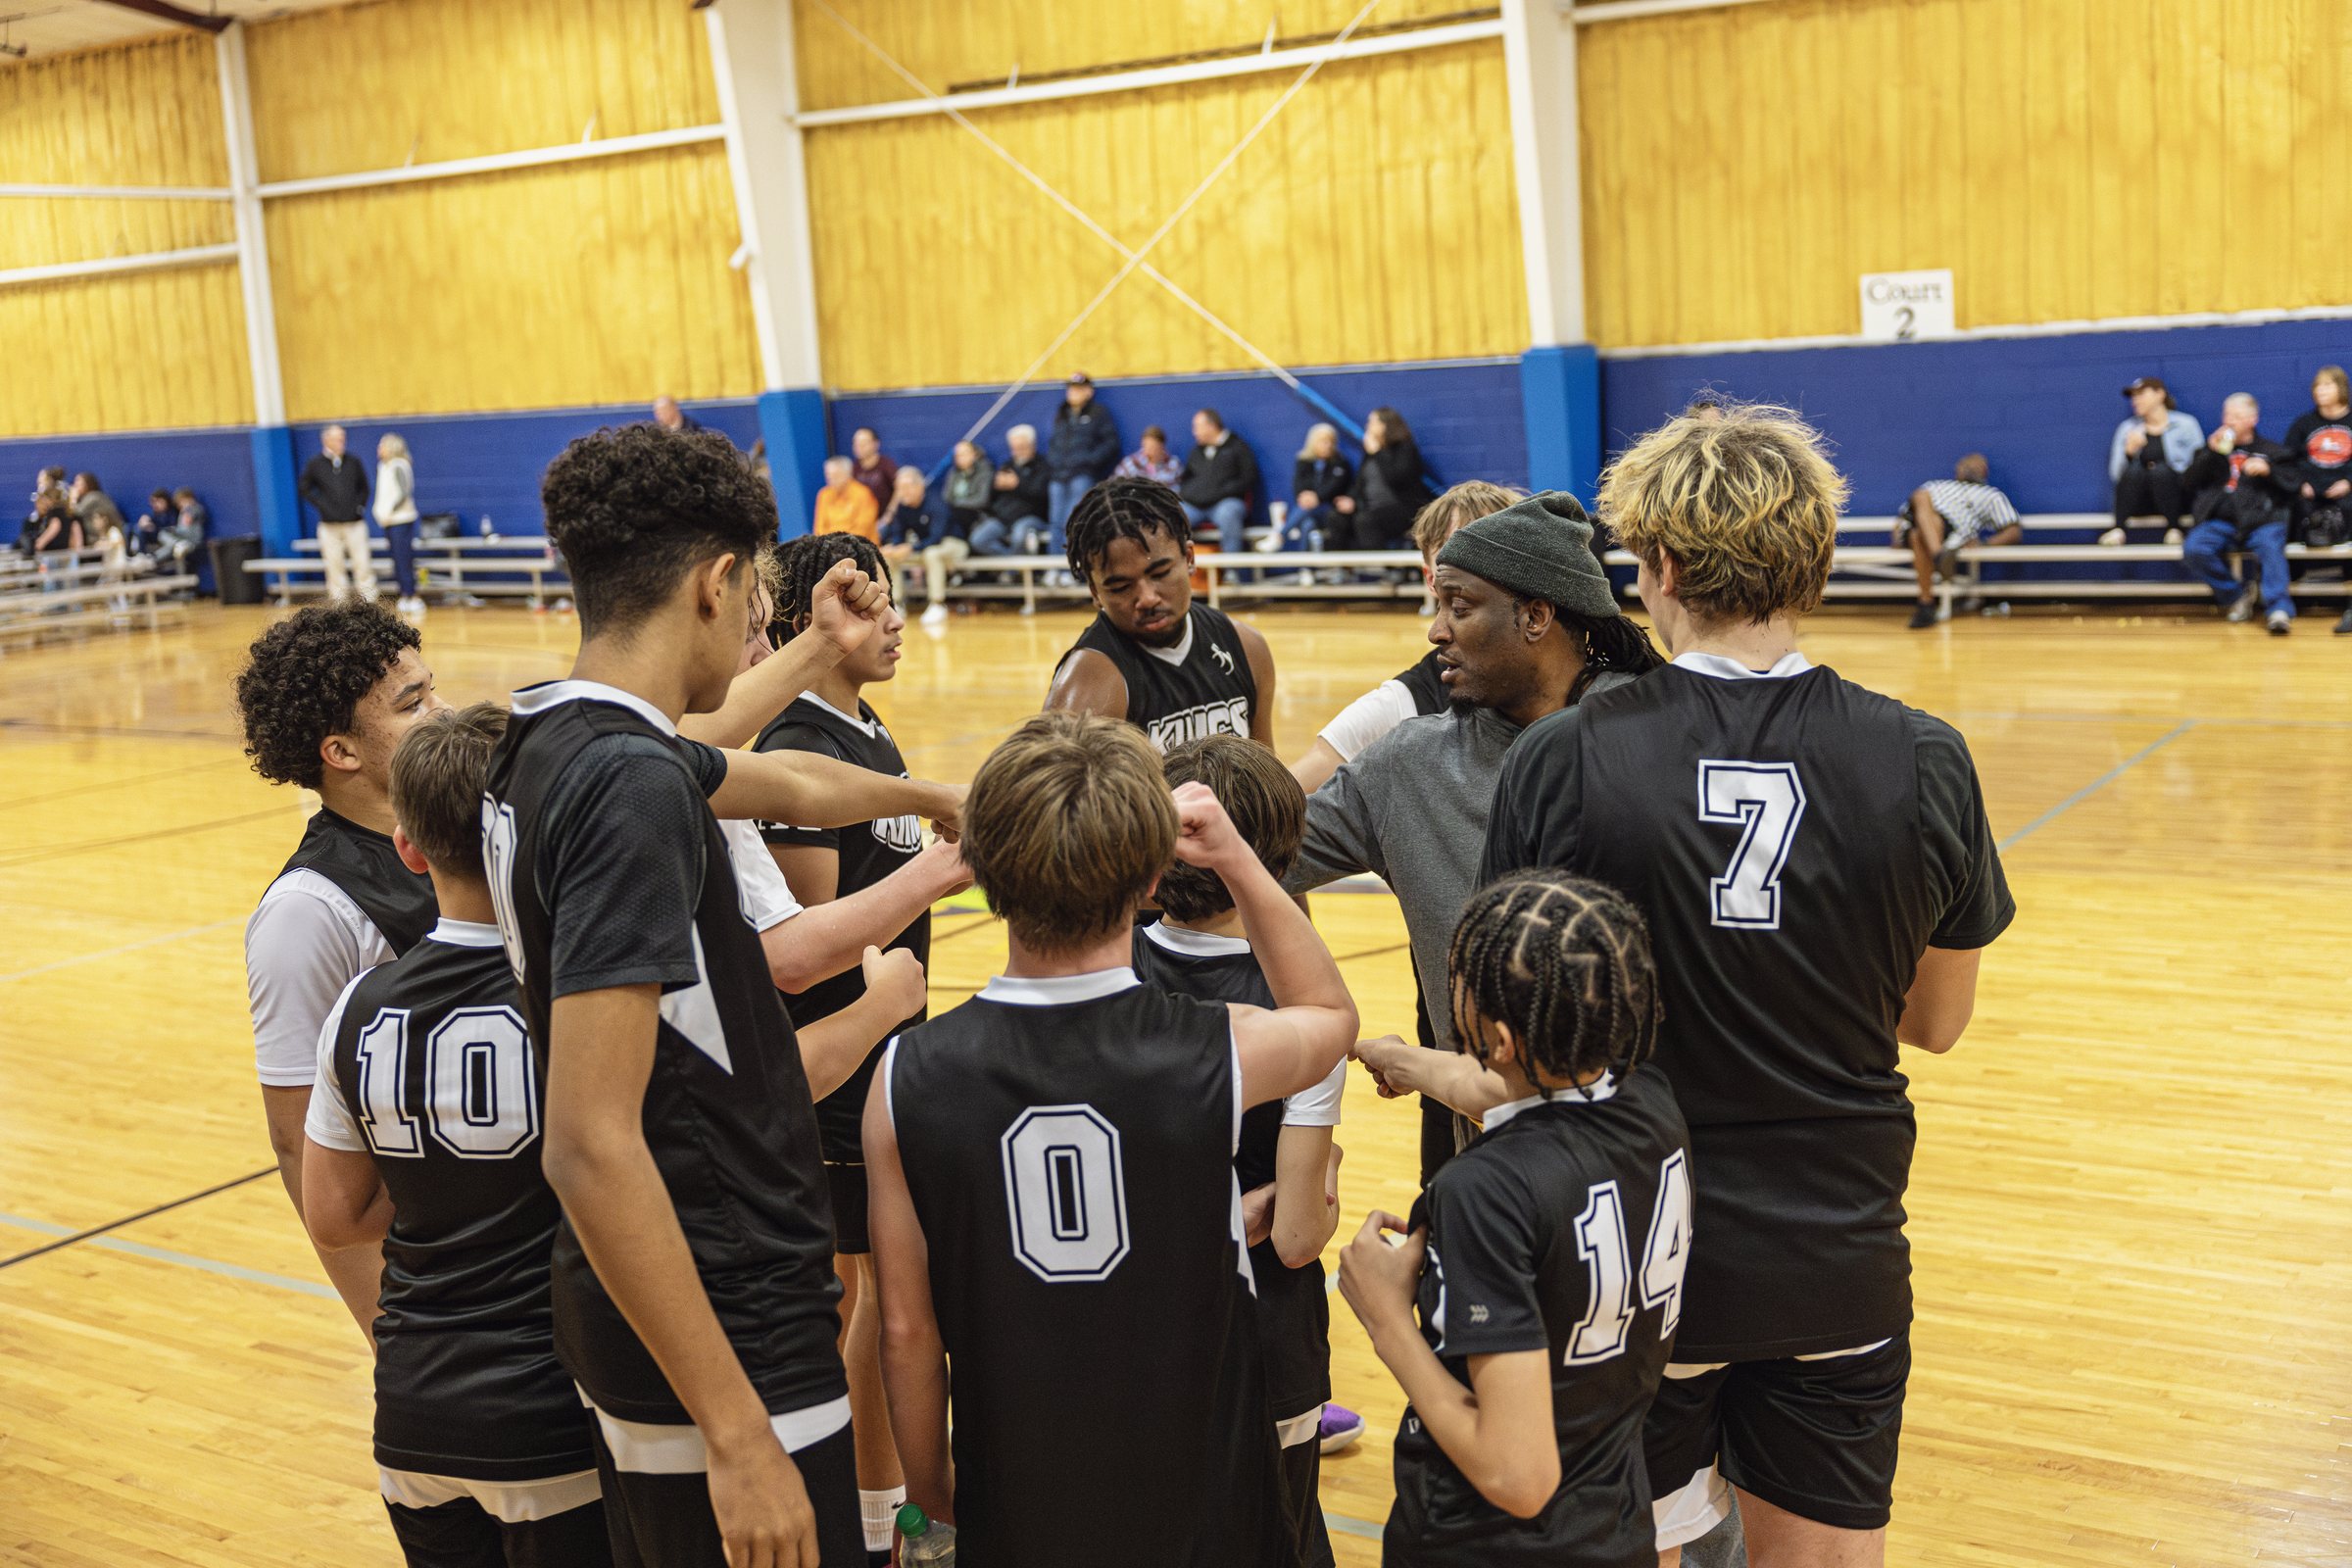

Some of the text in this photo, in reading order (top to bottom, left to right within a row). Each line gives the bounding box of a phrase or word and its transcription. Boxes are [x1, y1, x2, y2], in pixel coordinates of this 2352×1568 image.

[1866, 277, 1942, 306] Court
[1893, 306, 1917, 339] 2
[1697, 760, 1807, 930] 7
[356, 1004, 539, 1160] 10
[1001, 1103, 1130, 1283] 0
[1564, 1148, 1693, 1366] 14
